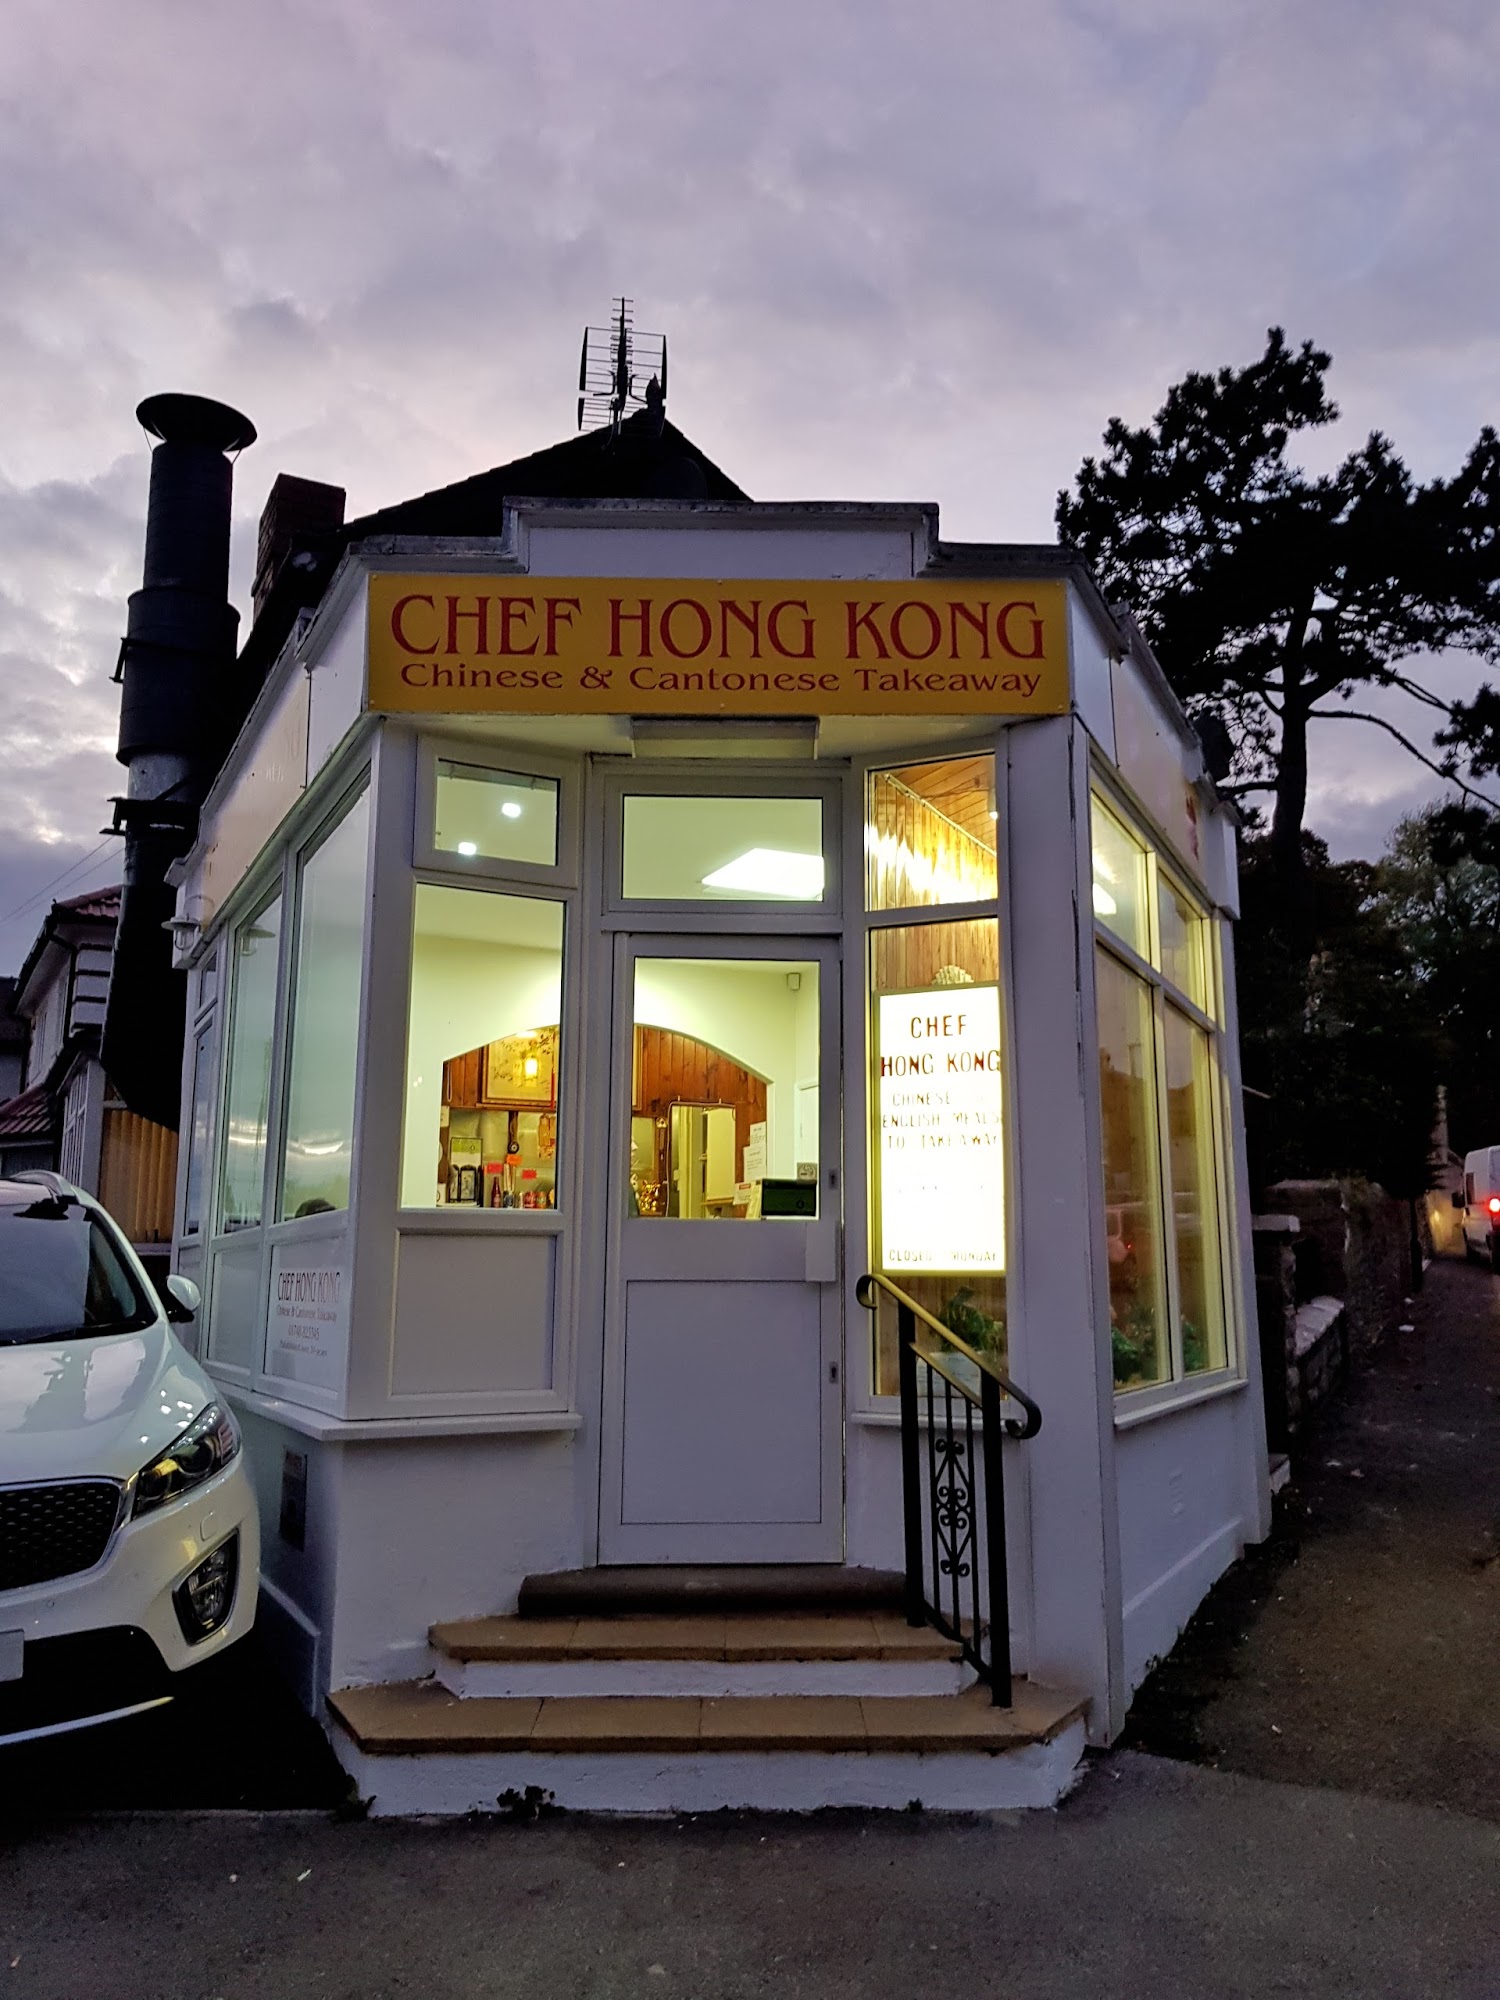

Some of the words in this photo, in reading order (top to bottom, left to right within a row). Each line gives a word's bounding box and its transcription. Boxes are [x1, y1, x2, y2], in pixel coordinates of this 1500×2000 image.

[390, 594, 583, 656] CHEF
[607, 597, 817, 659] HONG
[843, 600, 1046, 660] KONG
[400, 662, 563, 690] Chinese
[579, 666, 612, 690] &
[630, 666, 841, 692] Cantonese
[853, 667, 1042, 697] Takeaway
[910, 1013, 967, 1039] CHEF
[880, 1052, 934, 1077] HONG
[947, 1049, 1001, 1073] KONG
[892, 1090, 951, 1107] CHINESE
[882, 1113, 940, 1128] ENGLISH
[889, 1248, 932, 1262] CLOSED
[277, 1272, 295, 1301] CHEF
[295, 1272, 316, 1302] HONG
[317, 1272, 341, 1304] KONG
